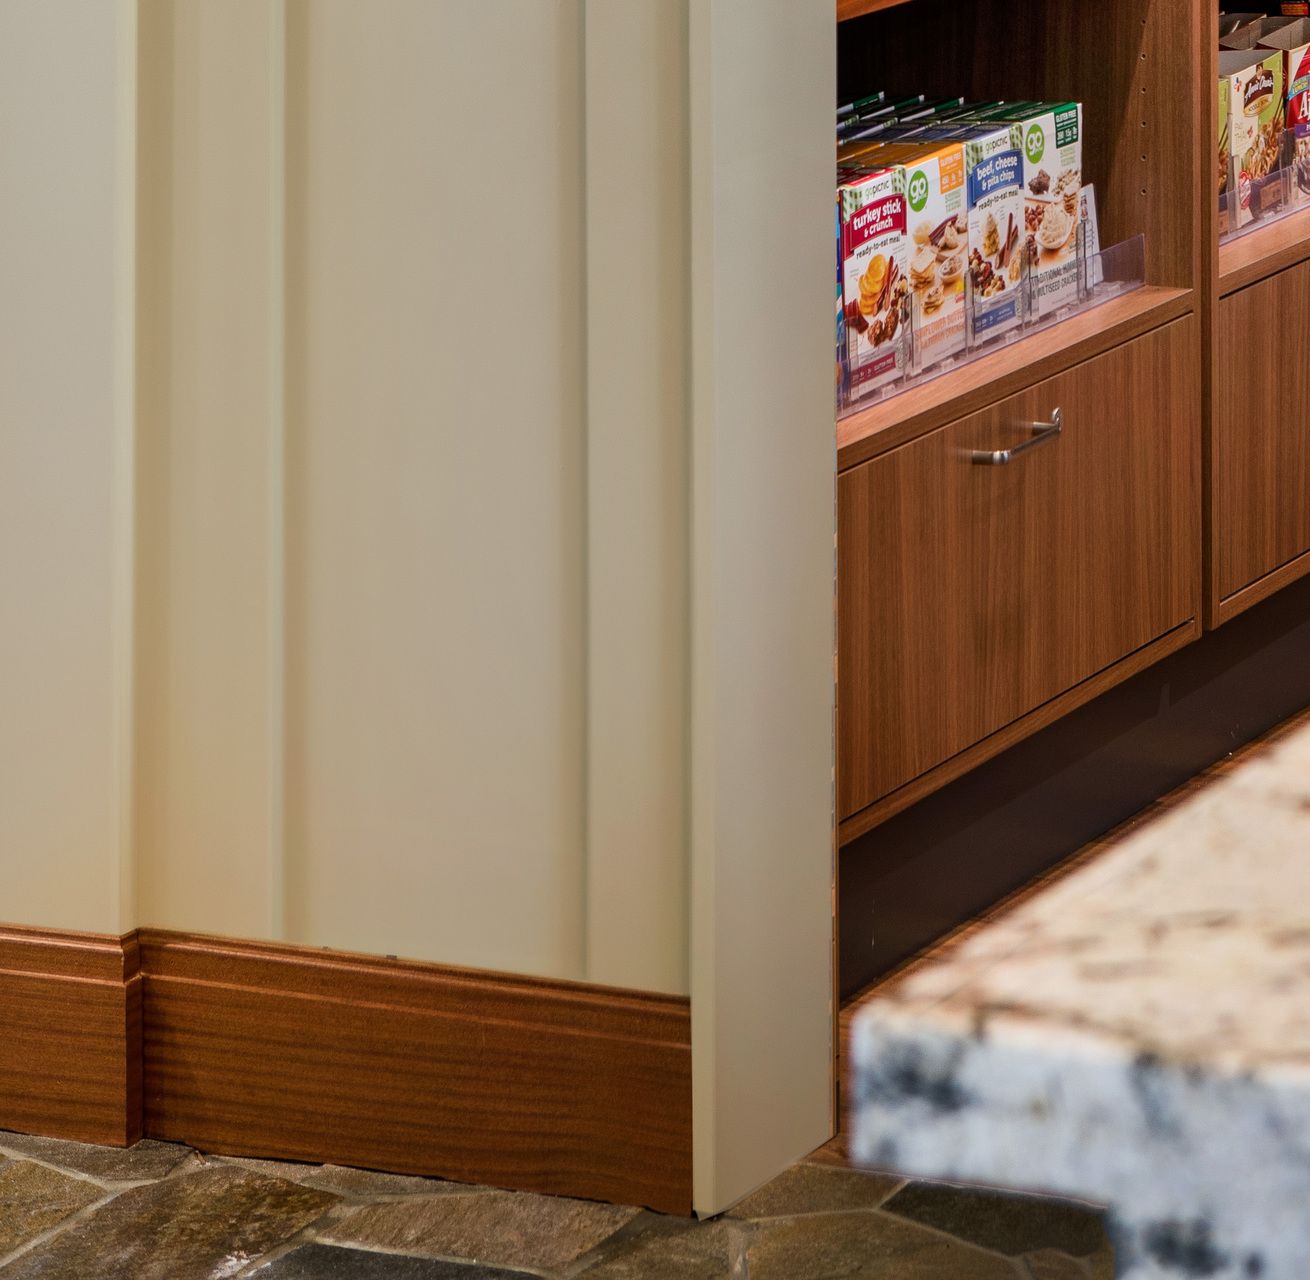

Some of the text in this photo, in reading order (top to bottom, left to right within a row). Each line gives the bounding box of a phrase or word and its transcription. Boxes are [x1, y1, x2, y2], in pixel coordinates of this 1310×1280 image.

[1028, 131, 1043, 156] go
[995, 156, 1018, 171] cheese
[1000, 170, 1015, 184] chips
[910, 177, 927, 204] go
[853, 198, 901, 231] turkey stick
[869, 216, 893, 235] crunch
[856, 237, 889, 259] ready-to-eat
